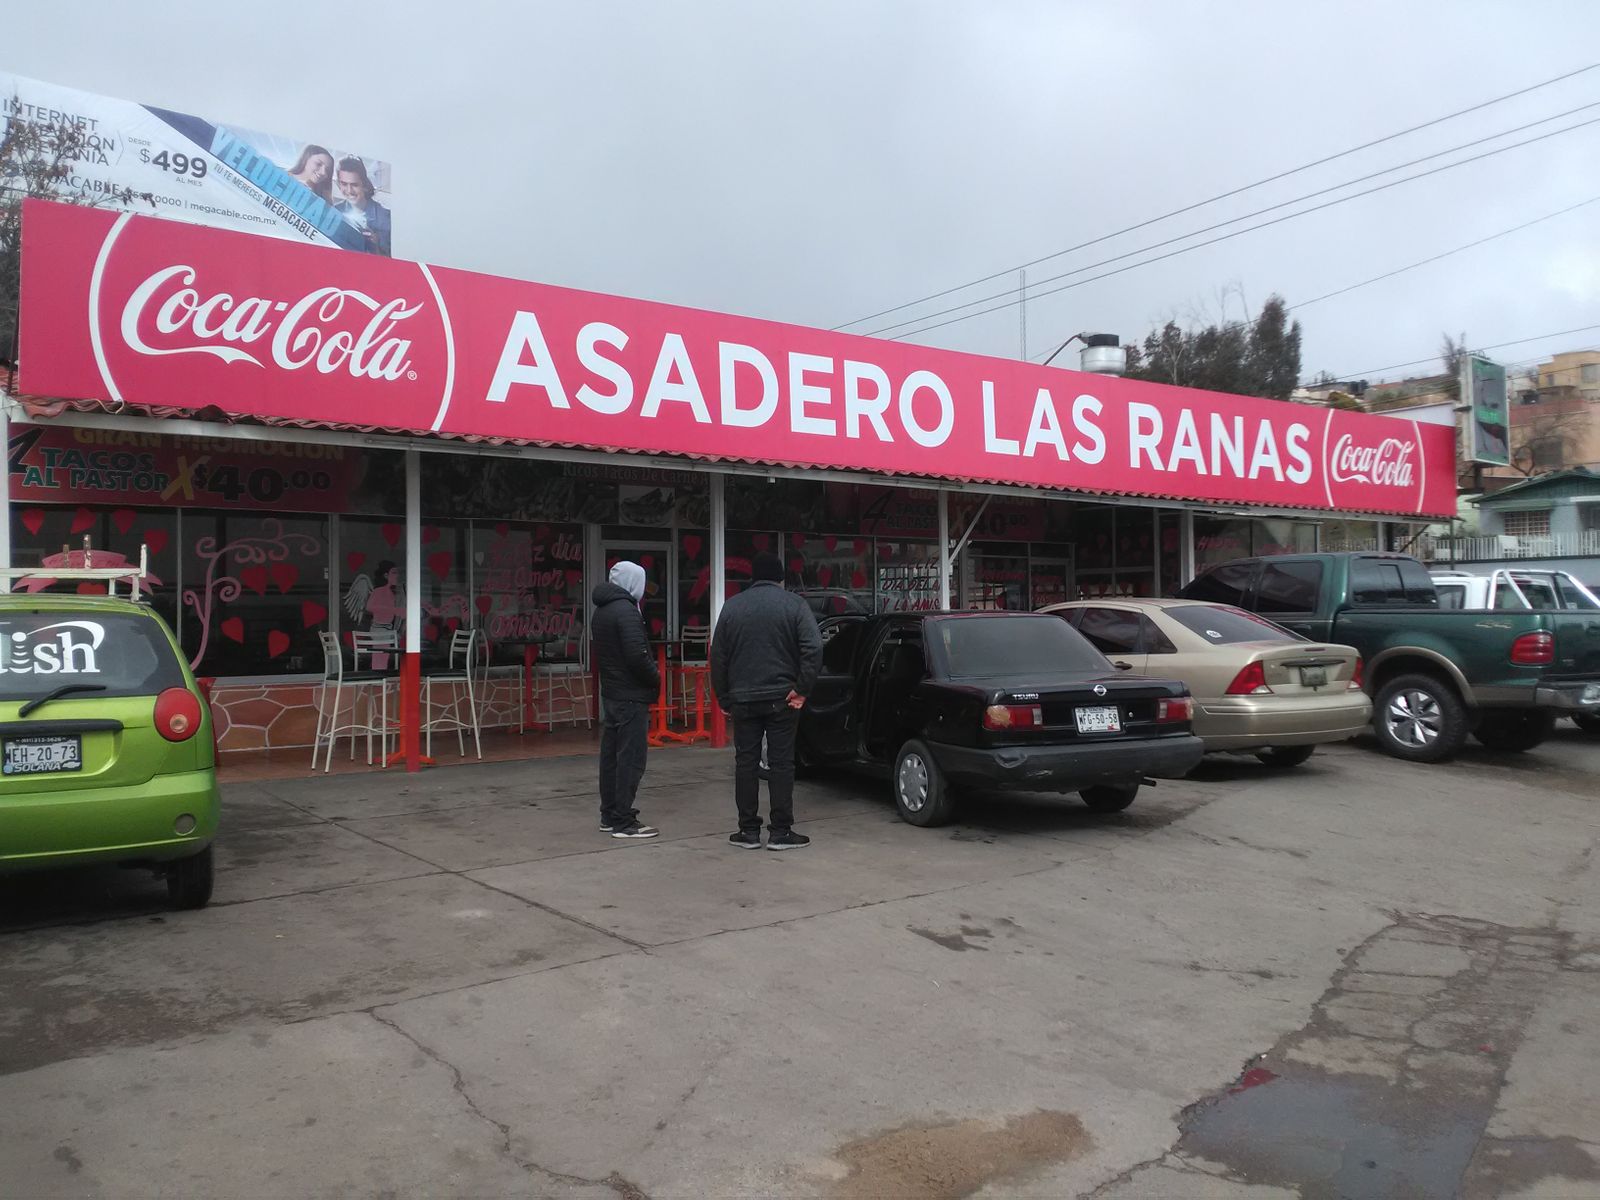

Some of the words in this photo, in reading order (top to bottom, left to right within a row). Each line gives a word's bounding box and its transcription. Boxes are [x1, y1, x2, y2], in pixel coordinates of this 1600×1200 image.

[3, 99, 99, 132] INTERNET
[139, 149, 207, 179] $499
[187, 178, 203, 187] MES
[190, 203, 277, 226] megacable.com.mx
[214, 163, 223, 173] TU
[222, 169, 232, 180] TE
[231, 174, 263, 203] MERECES
[262, 196, 318, 241] MEGACABLE
[121, 265, 424, 381] Coca-Cola
[485, 310, 955, 448] ASADERO
[982, 381, 1106, 464] LAS
[1128, 402, 1312, 484] RANAS
[40, 447, 155, 471] TACOS
[1332, 433, 1415, 487] Coca-Cola
[22, 465, 61, 488] AL
[69, 468, 168, 492] PASTOR
[14, 761, 61, 773] SOLANA
